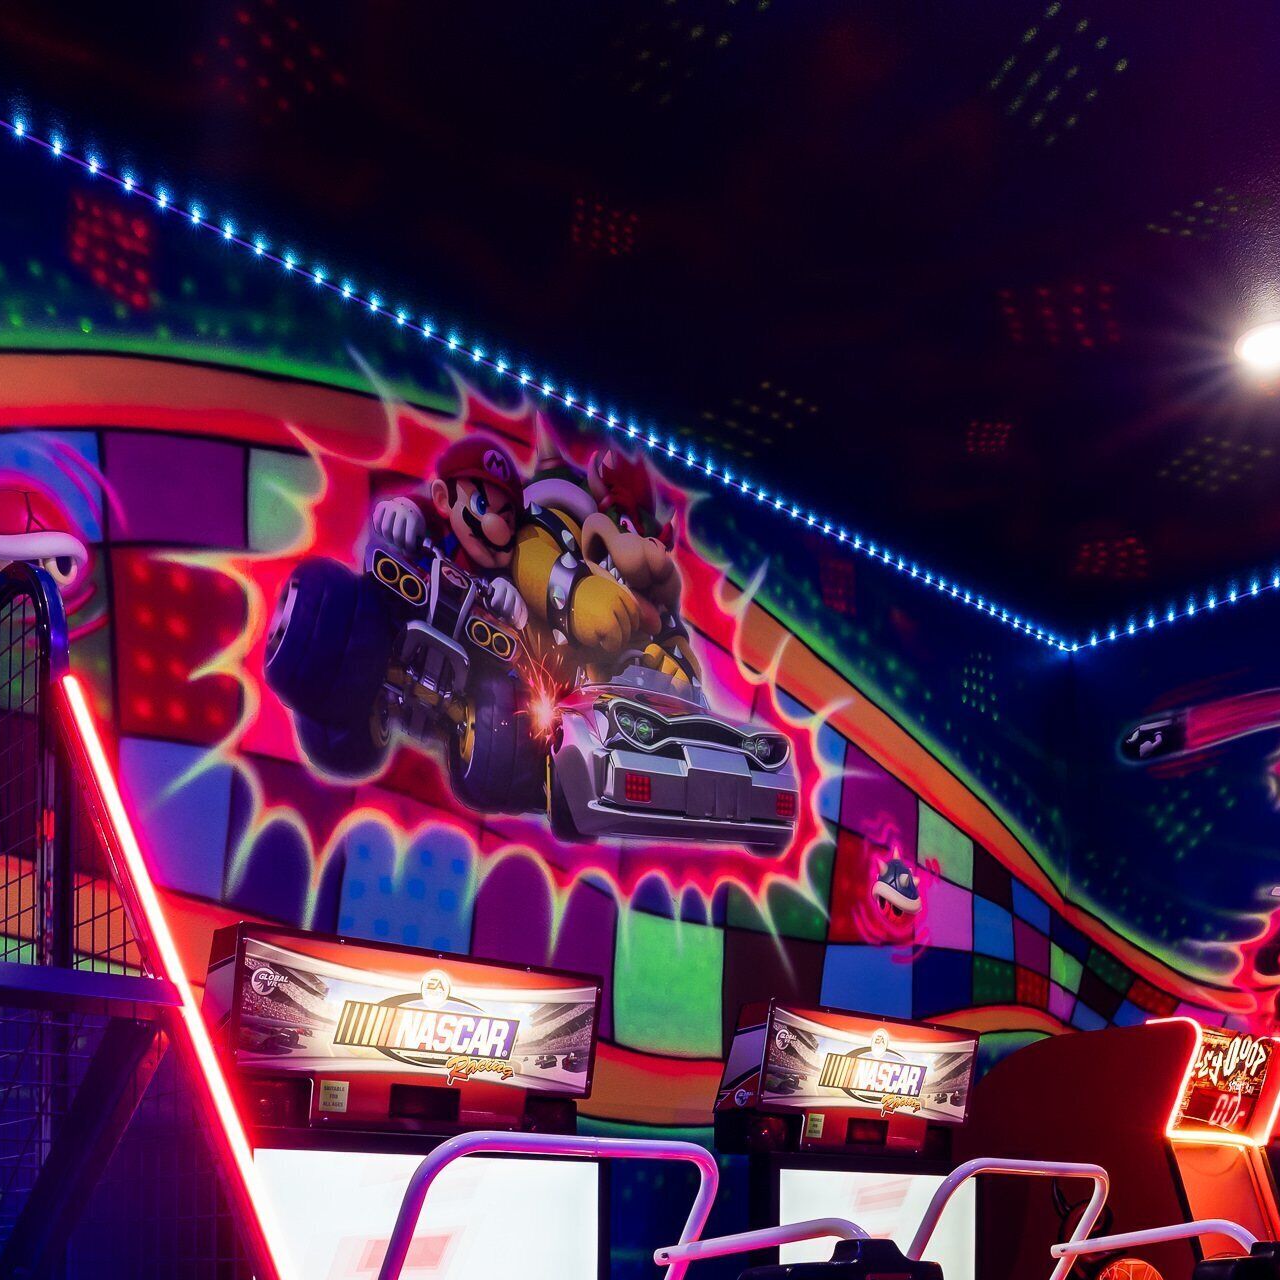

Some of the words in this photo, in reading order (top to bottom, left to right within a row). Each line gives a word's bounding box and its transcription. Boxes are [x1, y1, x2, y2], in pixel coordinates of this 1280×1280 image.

[258, 973, 289, 983] GLOBAL
[267, 980, 279, 988] VR
[427, 978, 445, 991] EA
[394, 1009, 510, 1058] NASCAR
[446, 1055, 515, 1085] Racing
[857, 1058, 922, 1096] NASCAR
